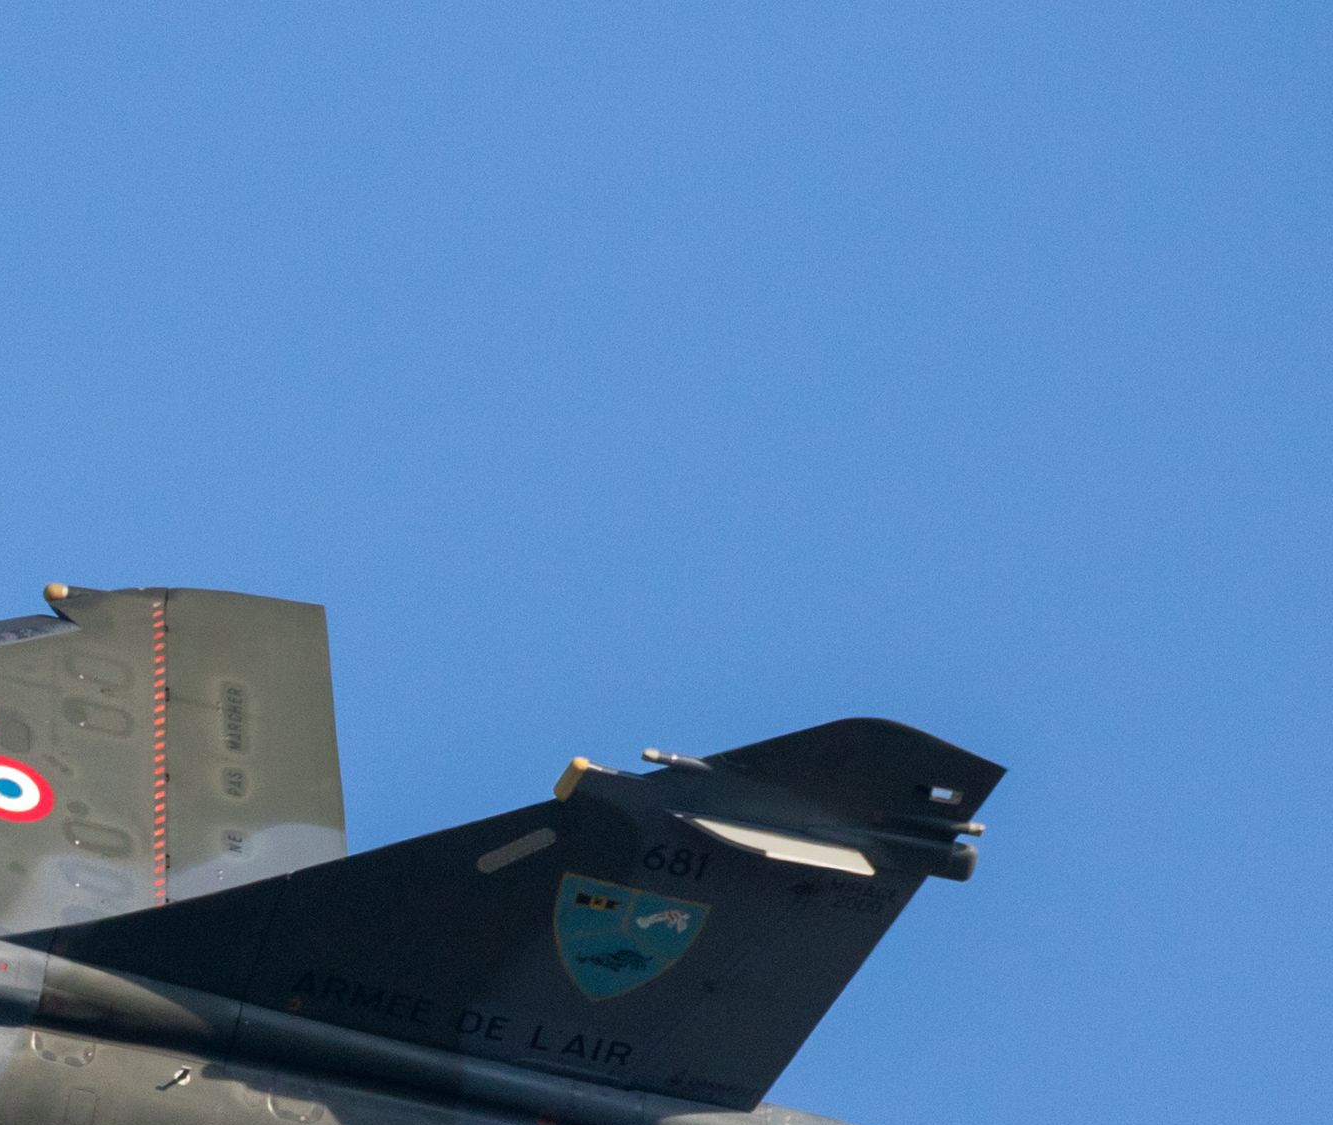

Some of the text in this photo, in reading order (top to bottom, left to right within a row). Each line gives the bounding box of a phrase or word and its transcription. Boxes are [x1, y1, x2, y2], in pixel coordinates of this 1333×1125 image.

[227, 687, 244, 853] NE PAS MARCHER
[643, 844, 710, 881] 681
[290, 971, 633, 1067] ARMEE DE L'AIR
